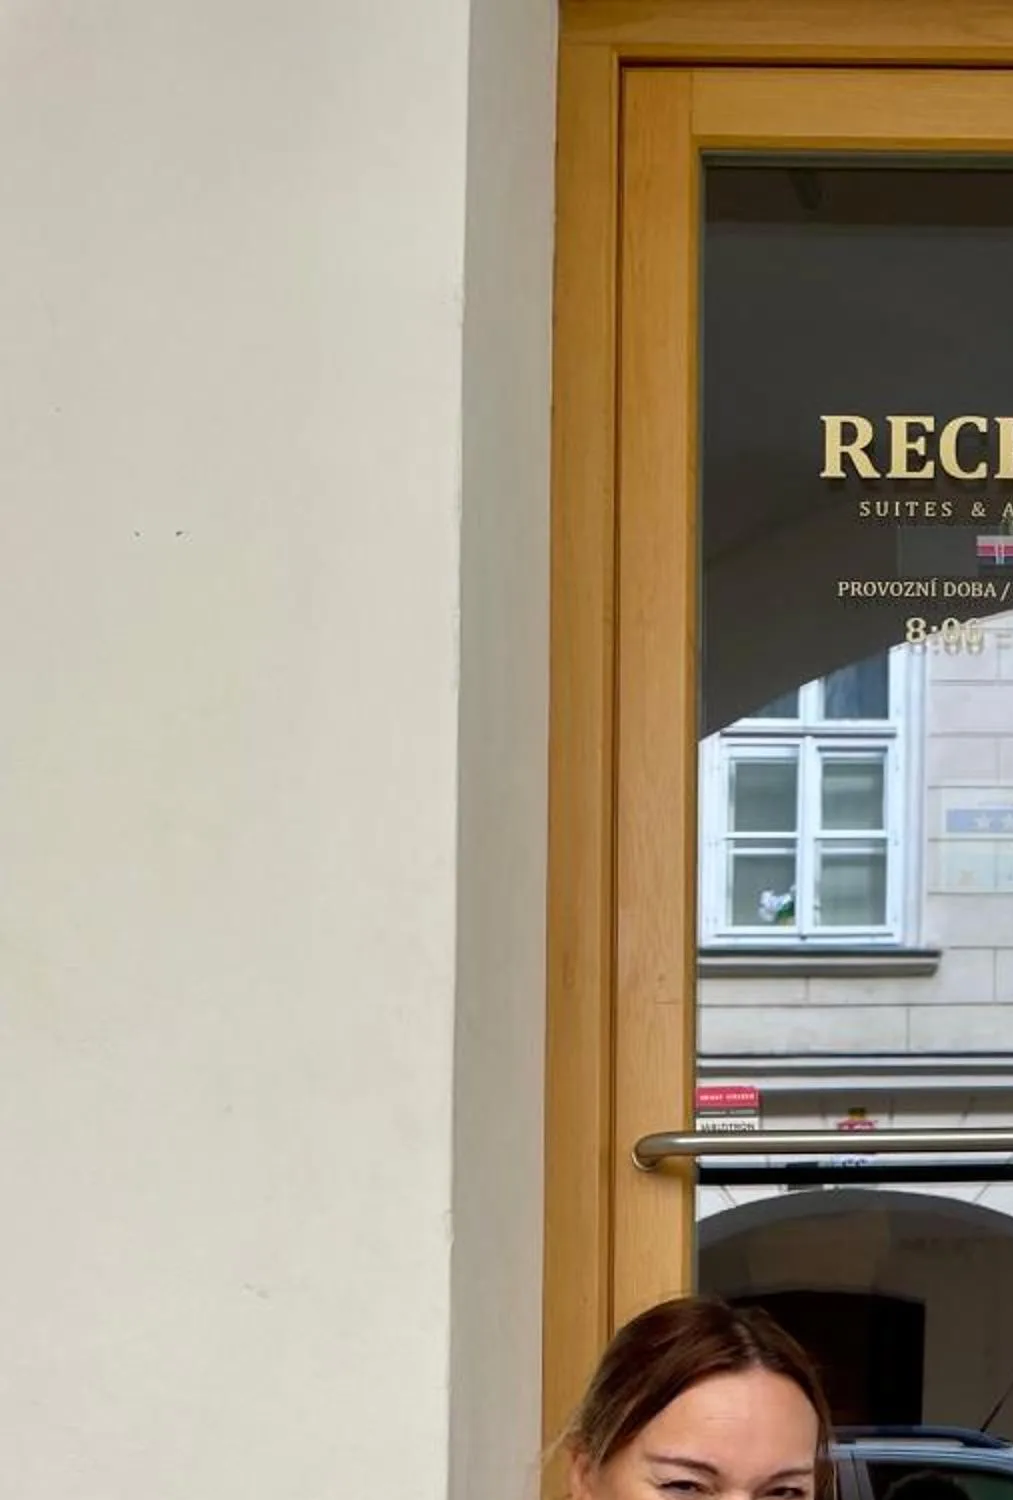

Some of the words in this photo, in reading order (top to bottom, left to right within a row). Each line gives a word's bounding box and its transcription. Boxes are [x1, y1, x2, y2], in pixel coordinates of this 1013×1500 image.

[859, 501, 953, 518] SUITES
[971, 502, 986, 517] &
[837, 578, 937, 598] PROVOZNÍ
[943, 581, 998, 598] DOBA
